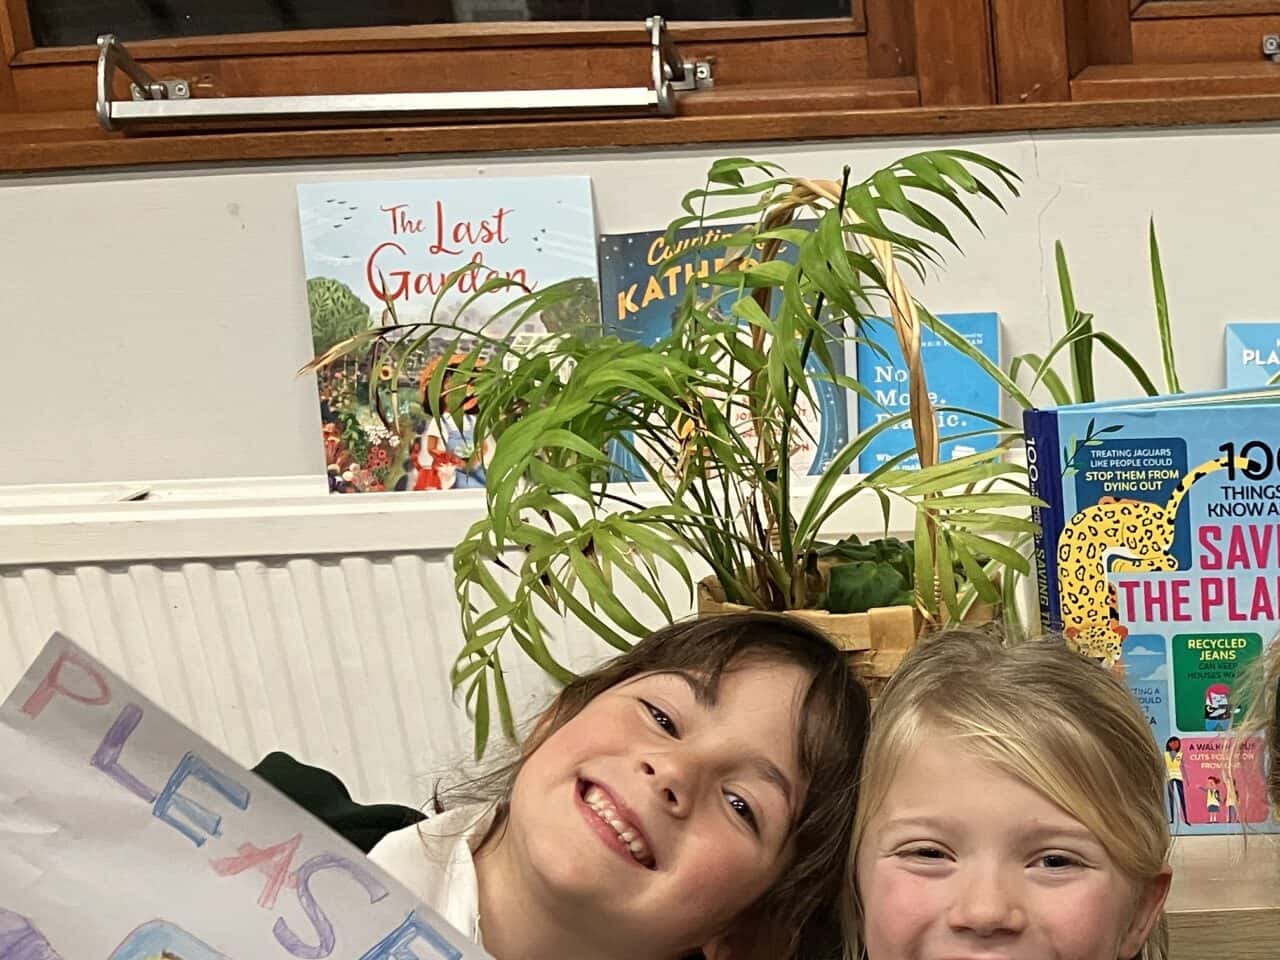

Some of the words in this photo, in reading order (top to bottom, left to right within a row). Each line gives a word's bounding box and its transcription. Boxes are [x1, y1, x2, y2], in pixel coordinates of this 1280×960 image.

[380, 203, 426, 236] The
[429, 200, 516, 256] Last
[874, 365, 908, 384] No
[875, 389, 947, 407] Moe.
[1090, 449, 1132, 459] TREATING
[1133, 448, 1172, 458] JAGUARS
[1090, 459, 1109, 468] LIKE
[1110, 459, 1142, 468] PEOPLE
[1143, 458, 1173, 467] COULD
[1085, 471, 1114, 482] STOP
[1115, 470, 1147, 481] THEM
[1148, 469, 1180, 480] FROM
[1103, 481, 1138, 492] DYING
[1139, 480, 1163, 491] OUT
[1207, 502, 1265, 518] KNOW
[1118, 579, 1193, 623] THE
[1187, 638, 1247, 649] RECYCLED
[1199, 650, 1237, 661] JEANS
